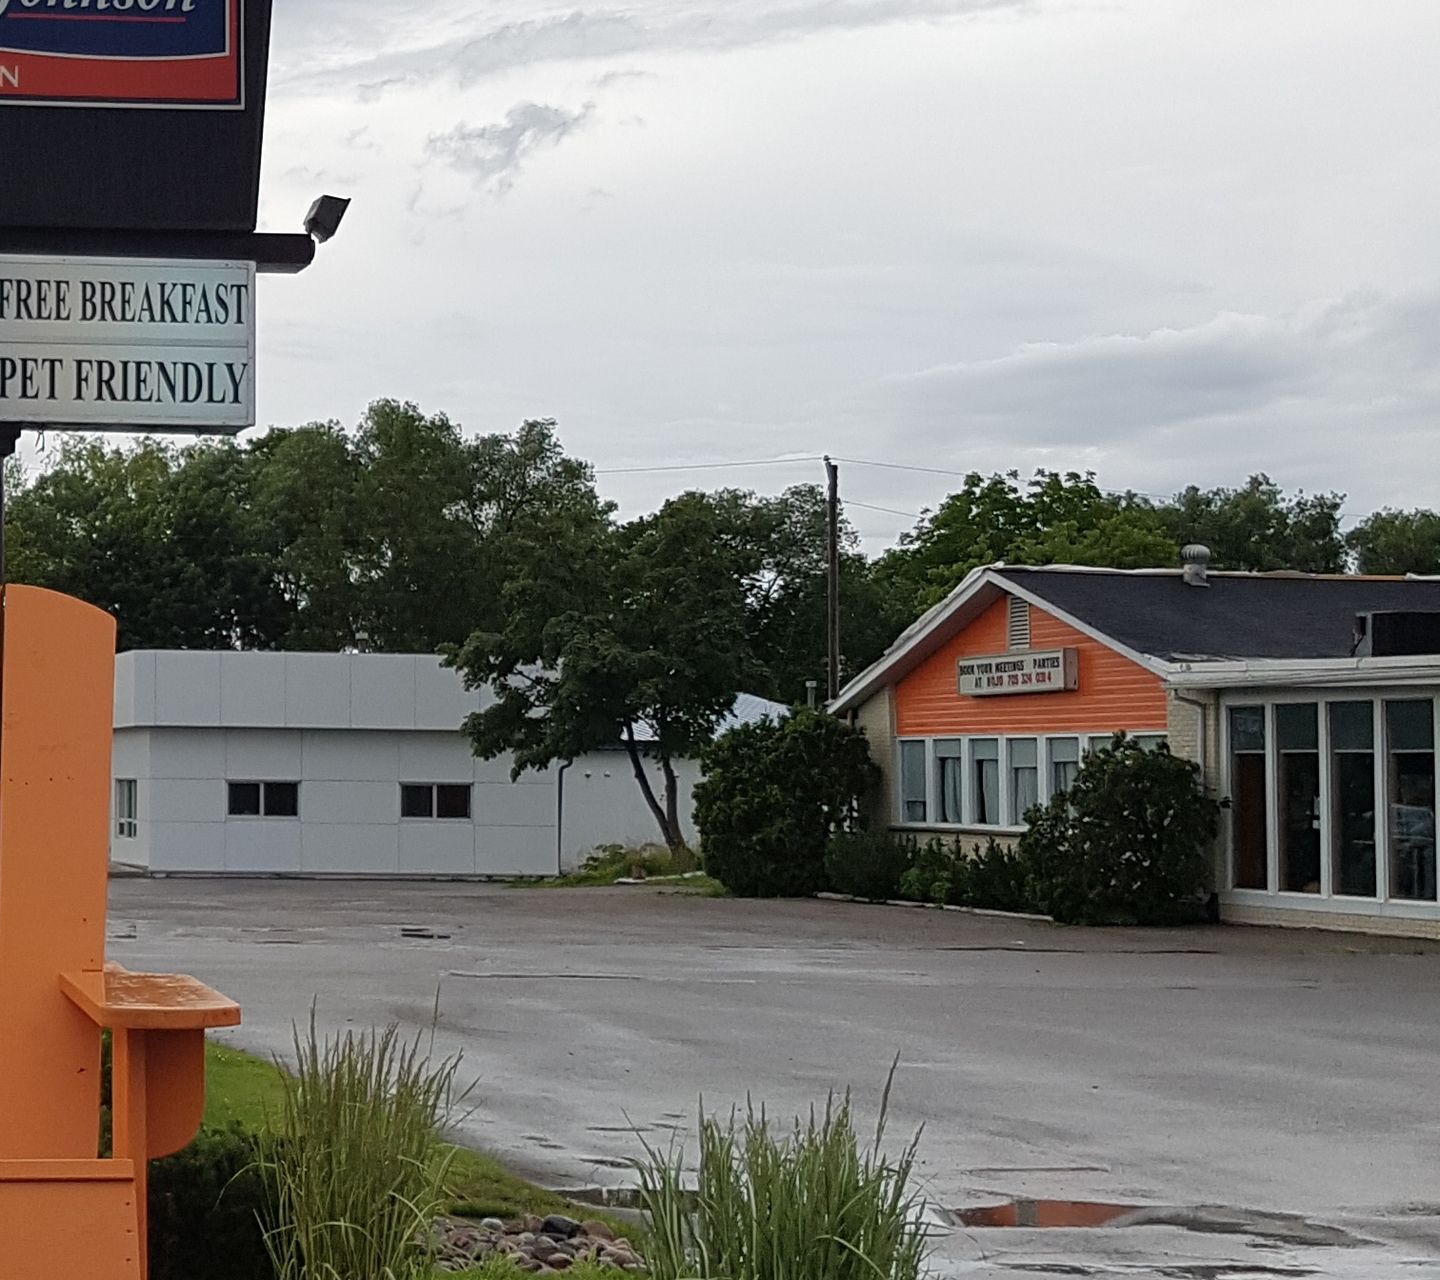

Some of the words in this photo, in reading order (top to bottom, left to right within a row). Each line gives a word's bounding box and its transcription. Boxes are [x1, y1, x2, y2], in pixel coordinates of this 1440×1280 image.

[79, 280, 249, 325] BREAKFAST
[72, 358, 249, 404] FRIENDLY
[976, 662, 992, 675] YOUR
[995, 660, 1024, 673] MEETINGS
[1033, 656, 1060, 669] PARTIES
[975, 676, 982, 688] AT
